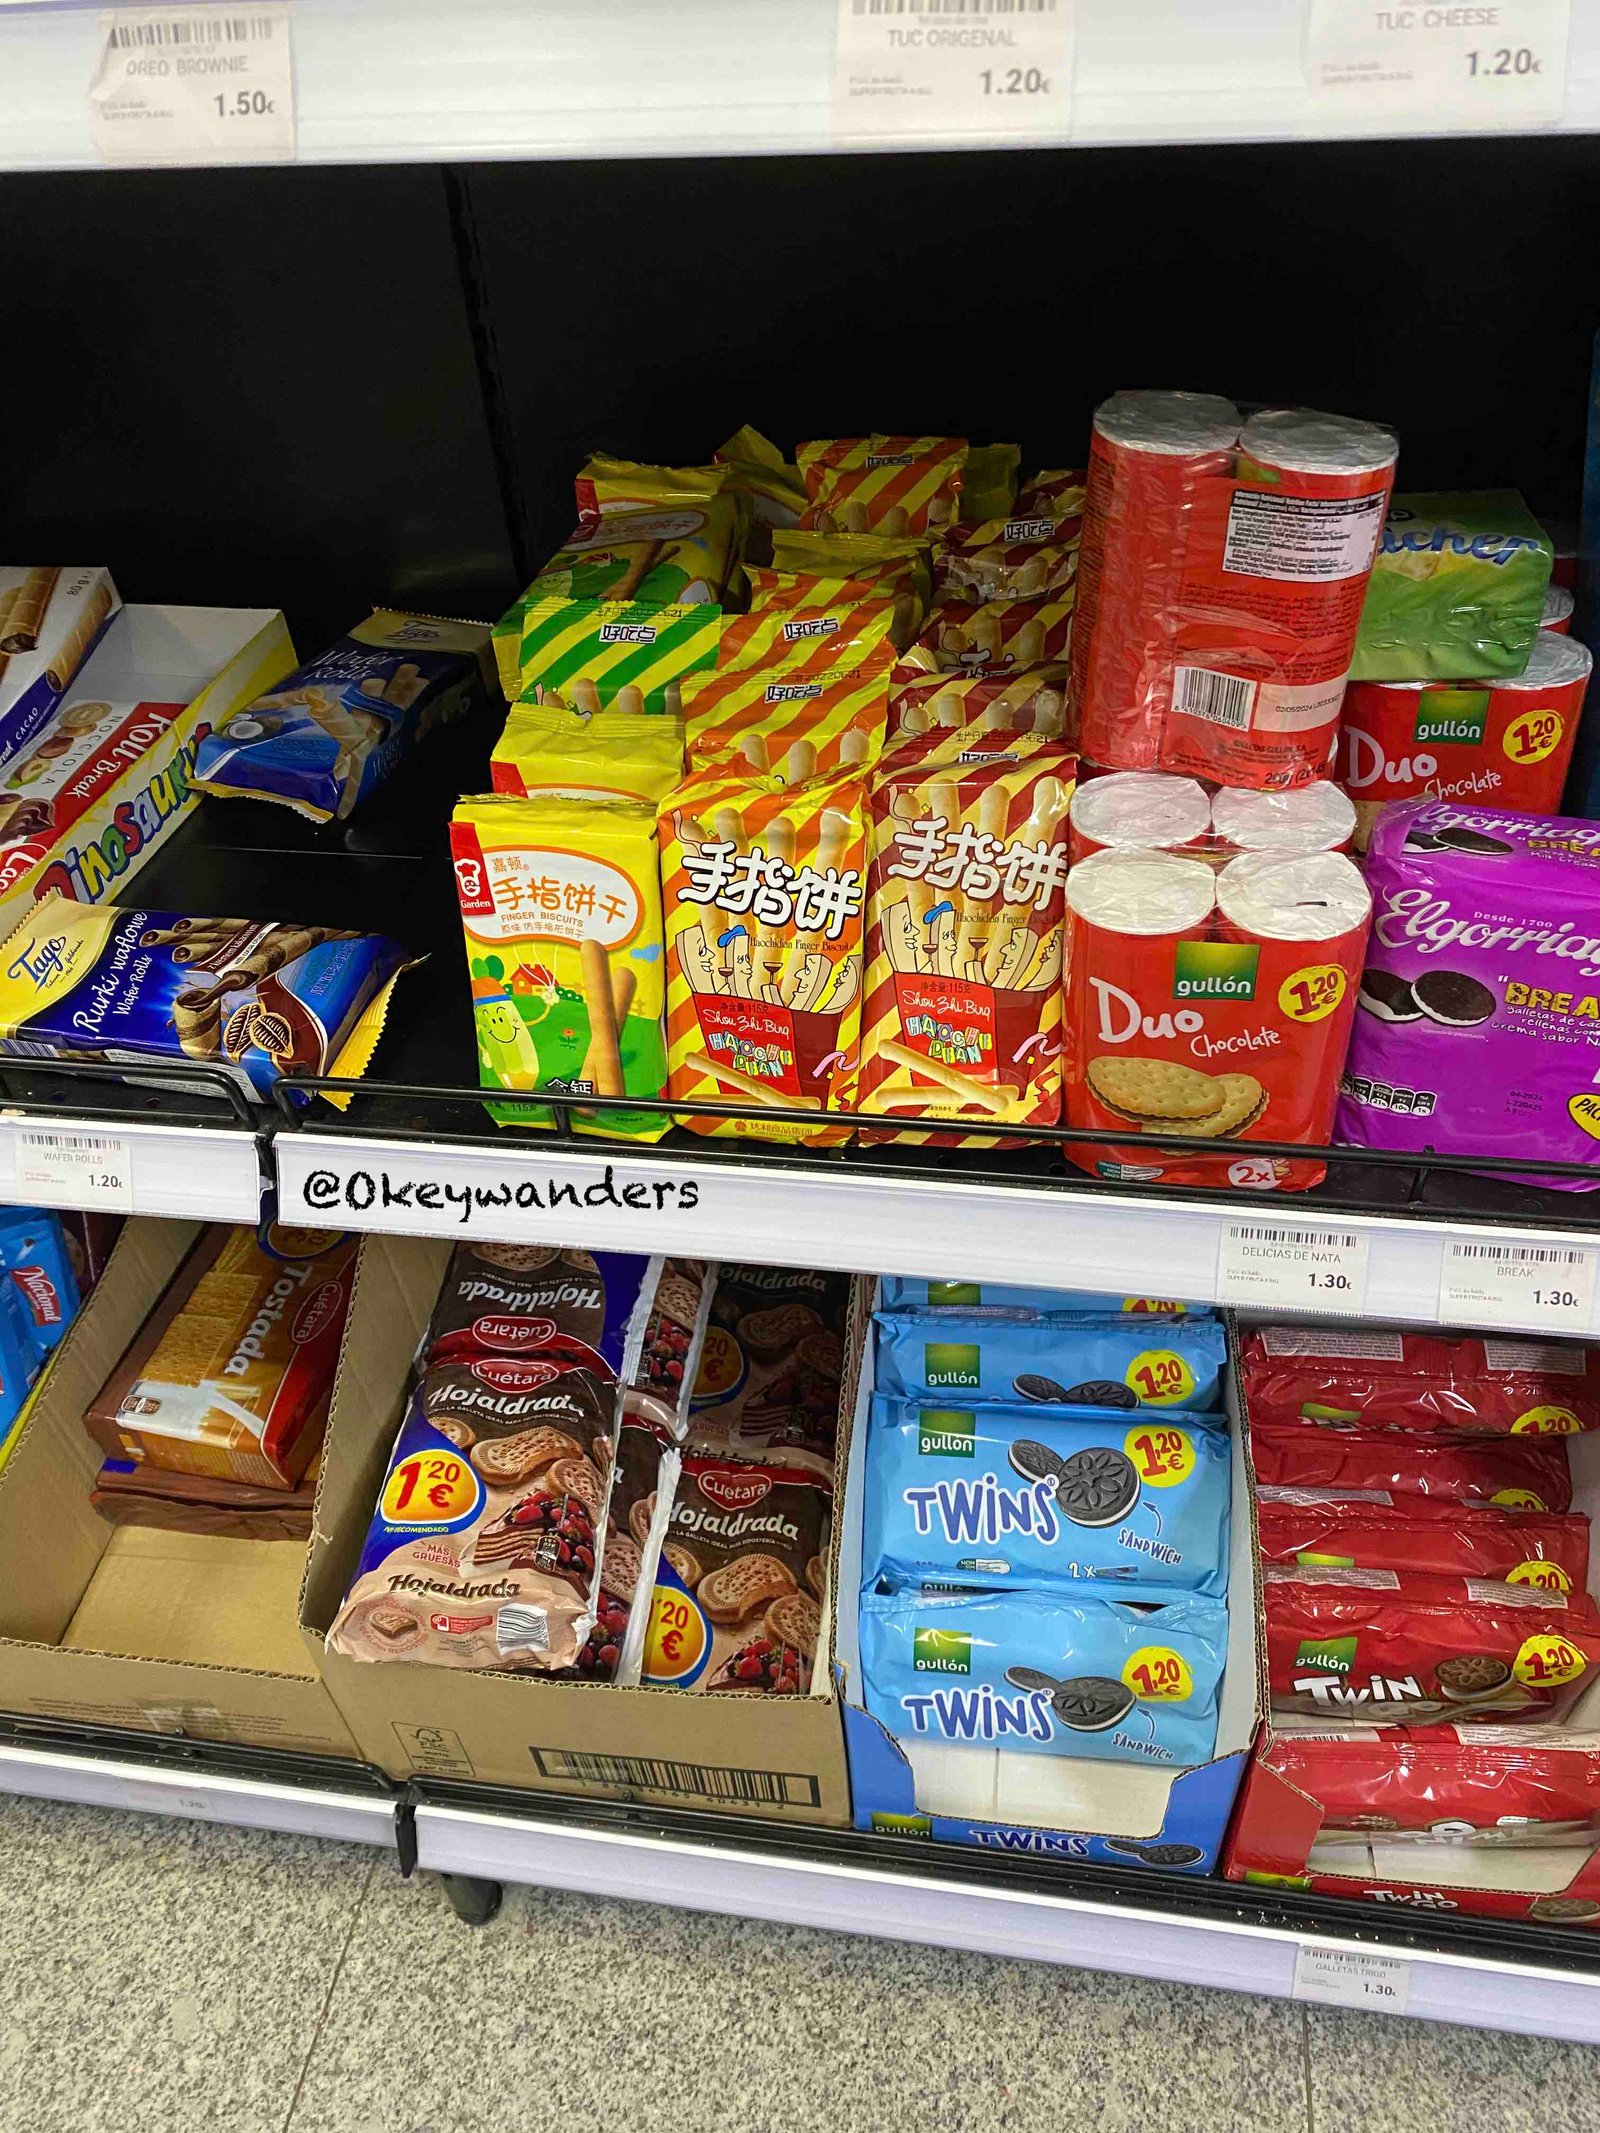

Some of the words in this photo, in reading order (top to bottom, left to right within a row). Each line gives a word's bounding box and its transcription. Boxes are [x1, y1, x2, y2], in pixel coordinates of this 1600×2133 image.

[1375, 12, 1414, 30] TUC
[1423, 7, 1500, 28] CHEESE
[887, 29, 922, 46] TUC
[926, 28, 1017, 47] ORIGENAL
[126, 60, 169, 76] OREO
[176, 55, 248, 76] BROWNIE
[1466, 48, 1543, 76] 1.20€
[980, 67, 1051, 95] 1.20€
[214, 90, 274, 117] 1.50€
[601, 624, 656, 643] 好吃点
[785, 617, 838, 640] 好吃点
[766, 684, 822, 702] 好吃点
[15, 706, 39, 740] CACAO
[1417, 719, 1480, 740] gullón
[1345, 725, 1437, 788] Duo
[64, 759, 122, 799] Break
[1424, 768, 1502, 801] Chocolate
[1418, 804, 1600, 846] lgorriag
[887, 816, 1068, 912] 手指饼
[492, 876, 627, 924] 手指饼干
[677, 841, 863, 939] 手指饼
[460, 899, 491, 909] Garden
[501, 912, 535, 922] FINGER
[540, 911, 583, 927] BISCUITS
[1473, 911, 1517, 925] Desde
[1520, 918, 1554, 928] 1700
[795, 939, 820, 953] Finger
[7, 936, 67, 994] Tago
[112, 982, 141, 1016] Wafer
[130, 954, 153, 983] Rolls
[1176, 974, 1252, 997] gullón
[72, 971, 120, 1033] Rurki
[1088, 976, 1204, 1044] Duo
[1506, 1006, 1555, 1022] galletas
[1559, 1014, 1576, 1026] de
[1522, 1018, 1570, 1034] rellenas
[1190, 1026, 1282, 1059] Chocolate
[1542, 1033, 1580, 1045] sabor
[929, 1040, 982, 1065] DIAN
[733, 1054, 785, 1077] DIAN
[44, 1152, 73, 1163] WAFER
[75, 1154, 103, 1165] ROLLS
[88, 1174, 123, 1188] 1.20€
[1235, 1165, 1270, 1185] 2x
[1242, 1246, 1291, 1259] DELICIAS
[1294, 1251, 1310, 1261] DE
[1311, 1252, 1341, 1264] NATA
[721, 1265, 827, 1292] ojaldrada
[1308, 1272, 1352, 1290] 1.30€
[1496, 1266, 1534, 1278] BREAK
[13, 1266, 62, 1322] Nacional
[457, 1281, 601, 1313] Hojaldrada
[1533, 1290, 1579, 1307] 1.30€
[223, 1265, 313, 1377] Tostada
[475, 1365, 551, 1385] Cuétara
[928, 1369, 977, 1386] gullón
[428, 1384, 585, 1418] Hojaldrada
[921, 1432, 973, 1453] gullón
[412, 1552, 461, 1568] GRUESAS
[388, 1573, 521, 1599] Hojaldrada
[916, 1656, 968, 1673] gullón
[1296, 1654, 1350, 1673] gullón
[1363, 1983, 1397, 1998] 1.30€
